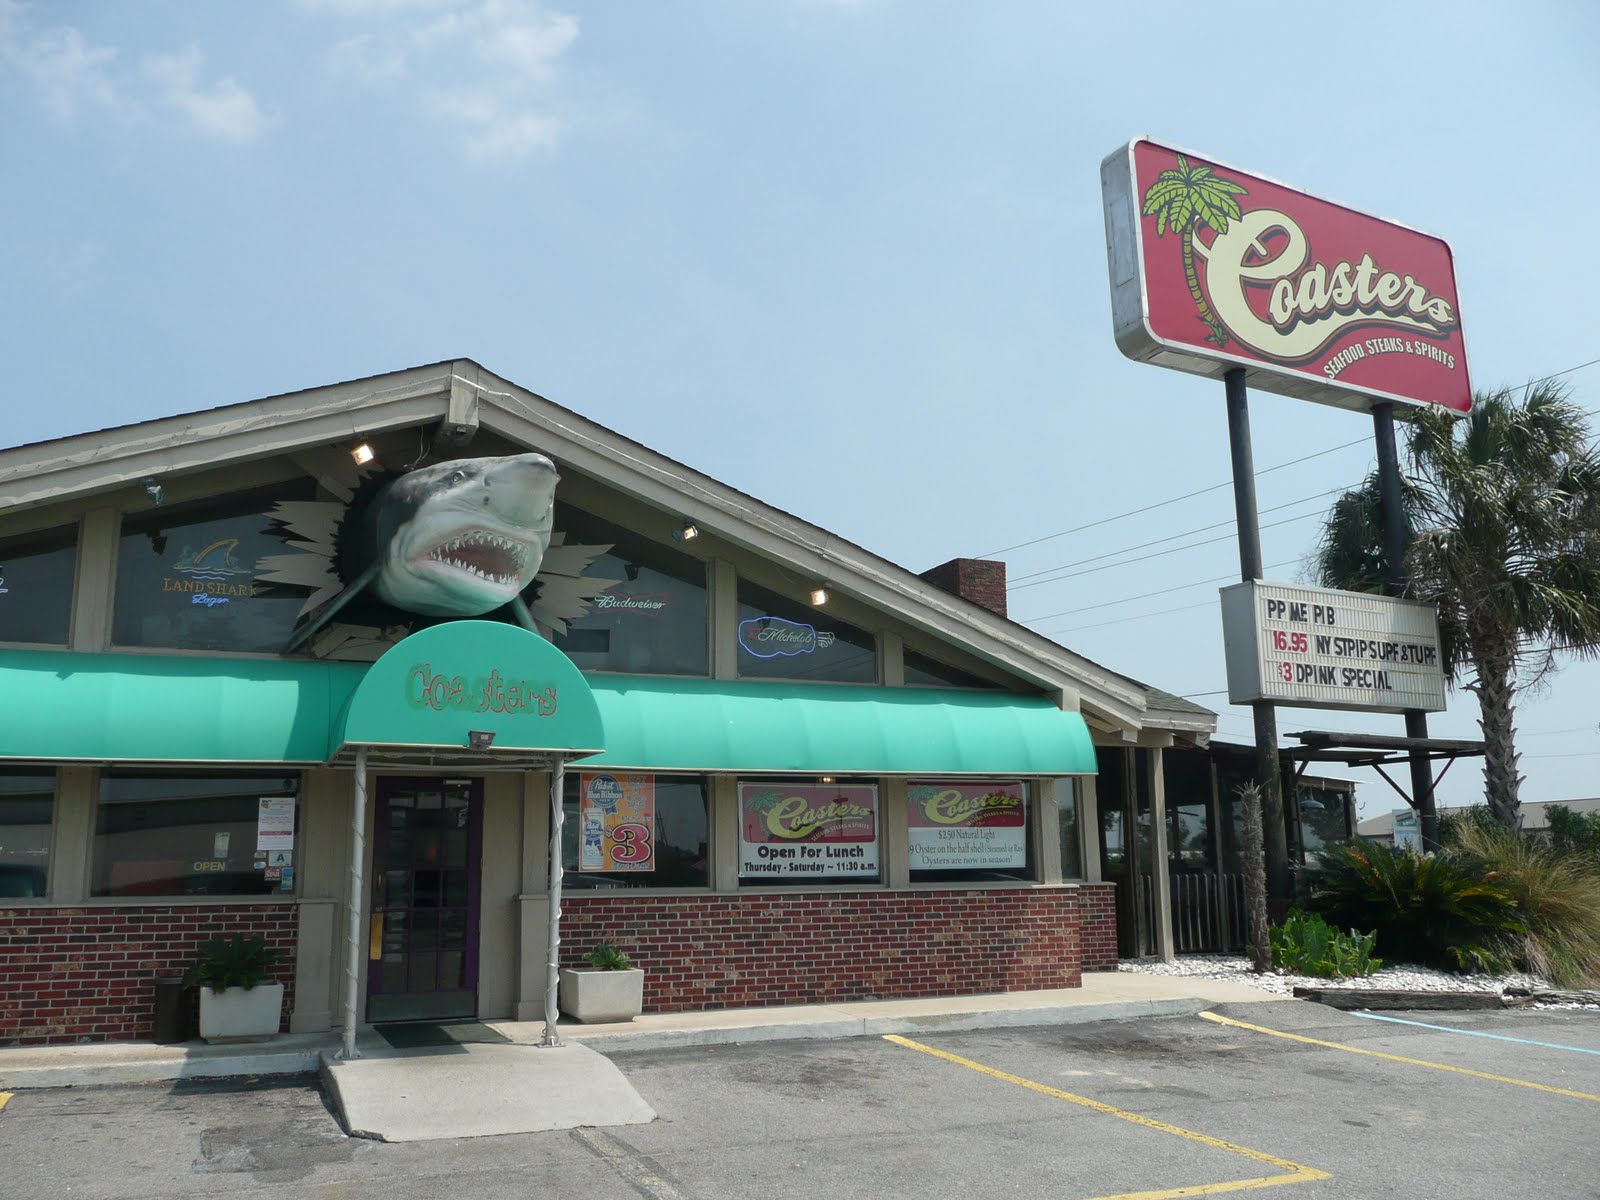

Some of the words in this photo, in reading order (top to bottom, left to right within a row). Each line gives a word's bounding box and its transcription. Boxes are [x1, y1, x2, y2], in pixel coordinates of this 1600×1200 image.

[1191, 208, 1456, 360] Coasters
[1365, 337, 1404, 355] STEAKS
[1405, 340, 1414, 353] &
[1414, 340, 1455, 369] SPIRITS
[191, 592, 230, 608] Lager
[594, 595, 666, 609] Budweiser
[757, 627, 813, 644] Michelob
[1273, 630, 1308, 653] 16.95
[1316, 634, 1331, 655] NY
[1342, 667, 1393, 690] SPECIAL
[920, 789, 1020, 824] Coasters
[762, 796, 871, 839] Coasters
[956, 828, 979, 839] Natural
[980, 827, 995, 843] Light
[276, 853, 285, 862] A
[757, 845, 796, 860] Open
[800, 846, 822, 858] For
[826, 845, 864, 858] Lunch
[915, 843, 936, 857] Oyster
[946, 842, 957, 853] the
[957, 842, 970, 853] half
[970, 842, 984, 853] shell
[193, 861, 226, 871] OPEN
[744, 862, 782, 873] Thursday
[789, 862, 824, 873] Saturday
[836, 862, 858, 871] 11:30
[860, 862, 877, 871] a.m.
[922, 856, 950, 868] Oysters
